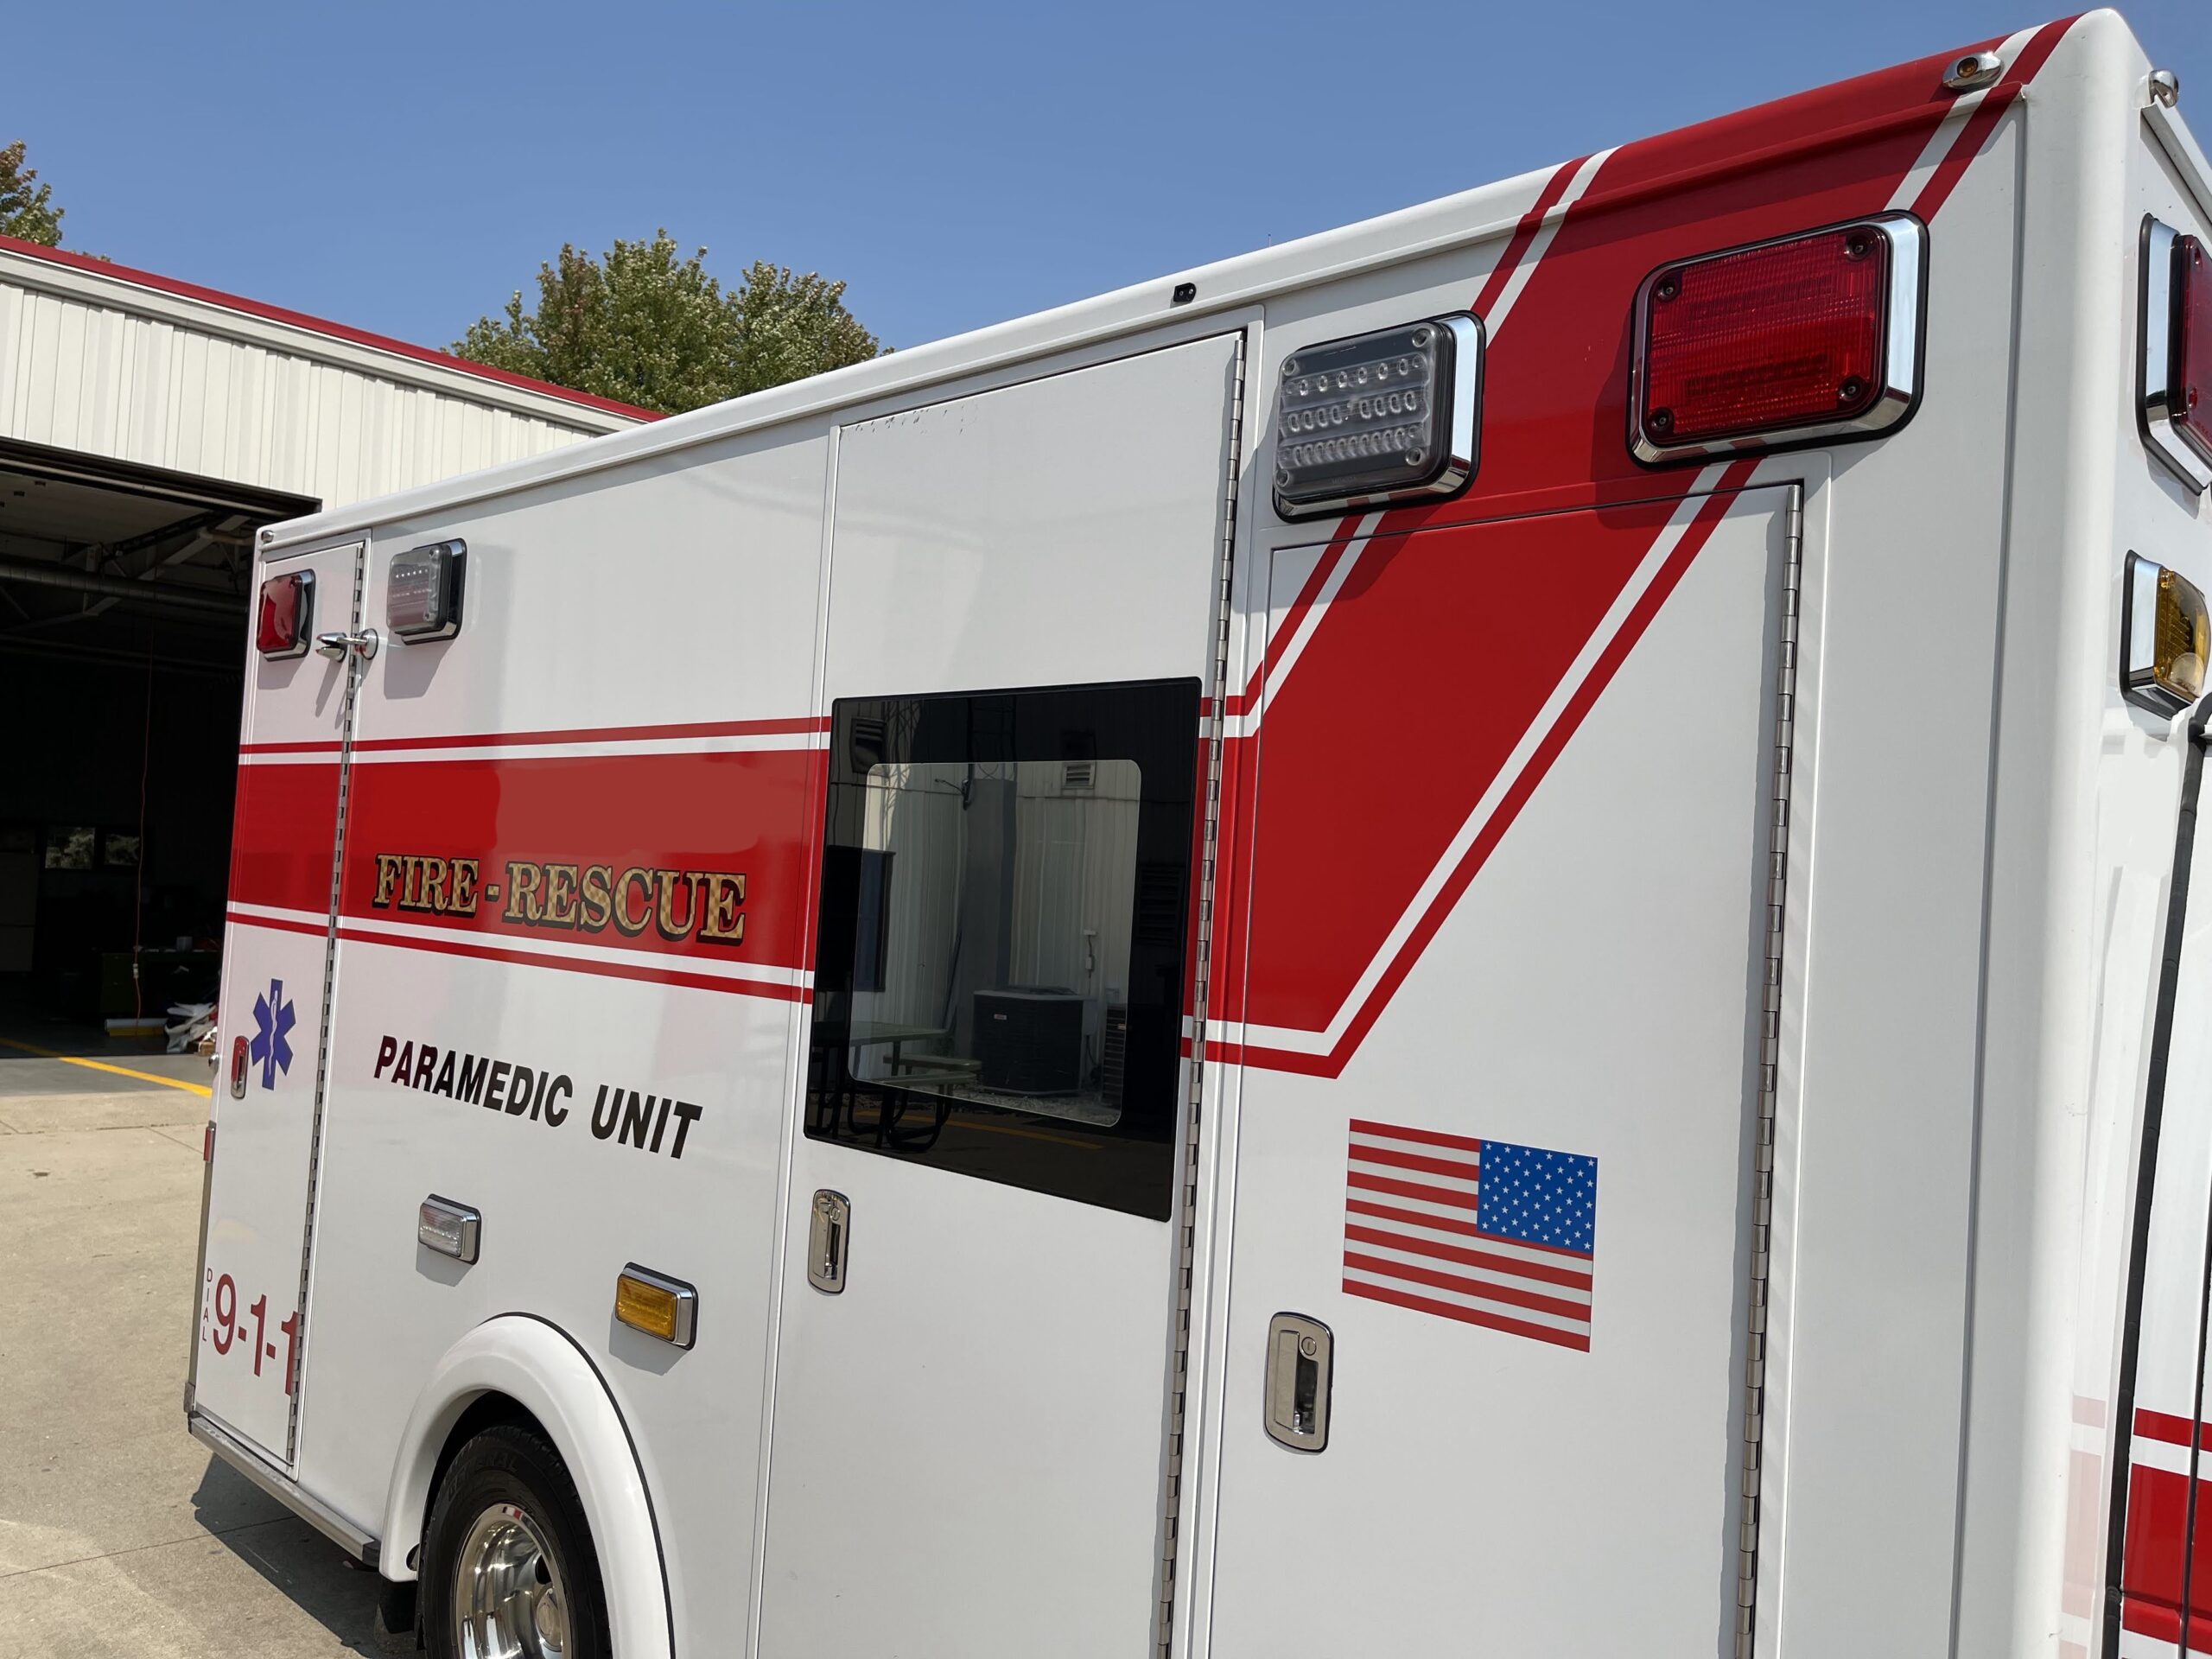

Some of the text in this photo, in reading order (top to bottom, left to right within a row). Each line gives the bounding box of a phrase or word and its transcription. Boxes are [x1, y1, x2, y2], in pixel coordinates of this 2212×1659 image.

[373, 1034, 703, 1160] PARAMEDIC UNIT
[201, 1267, 213, 1342] DIAL
[213, 1273, 299, 1396] 9-1-1
